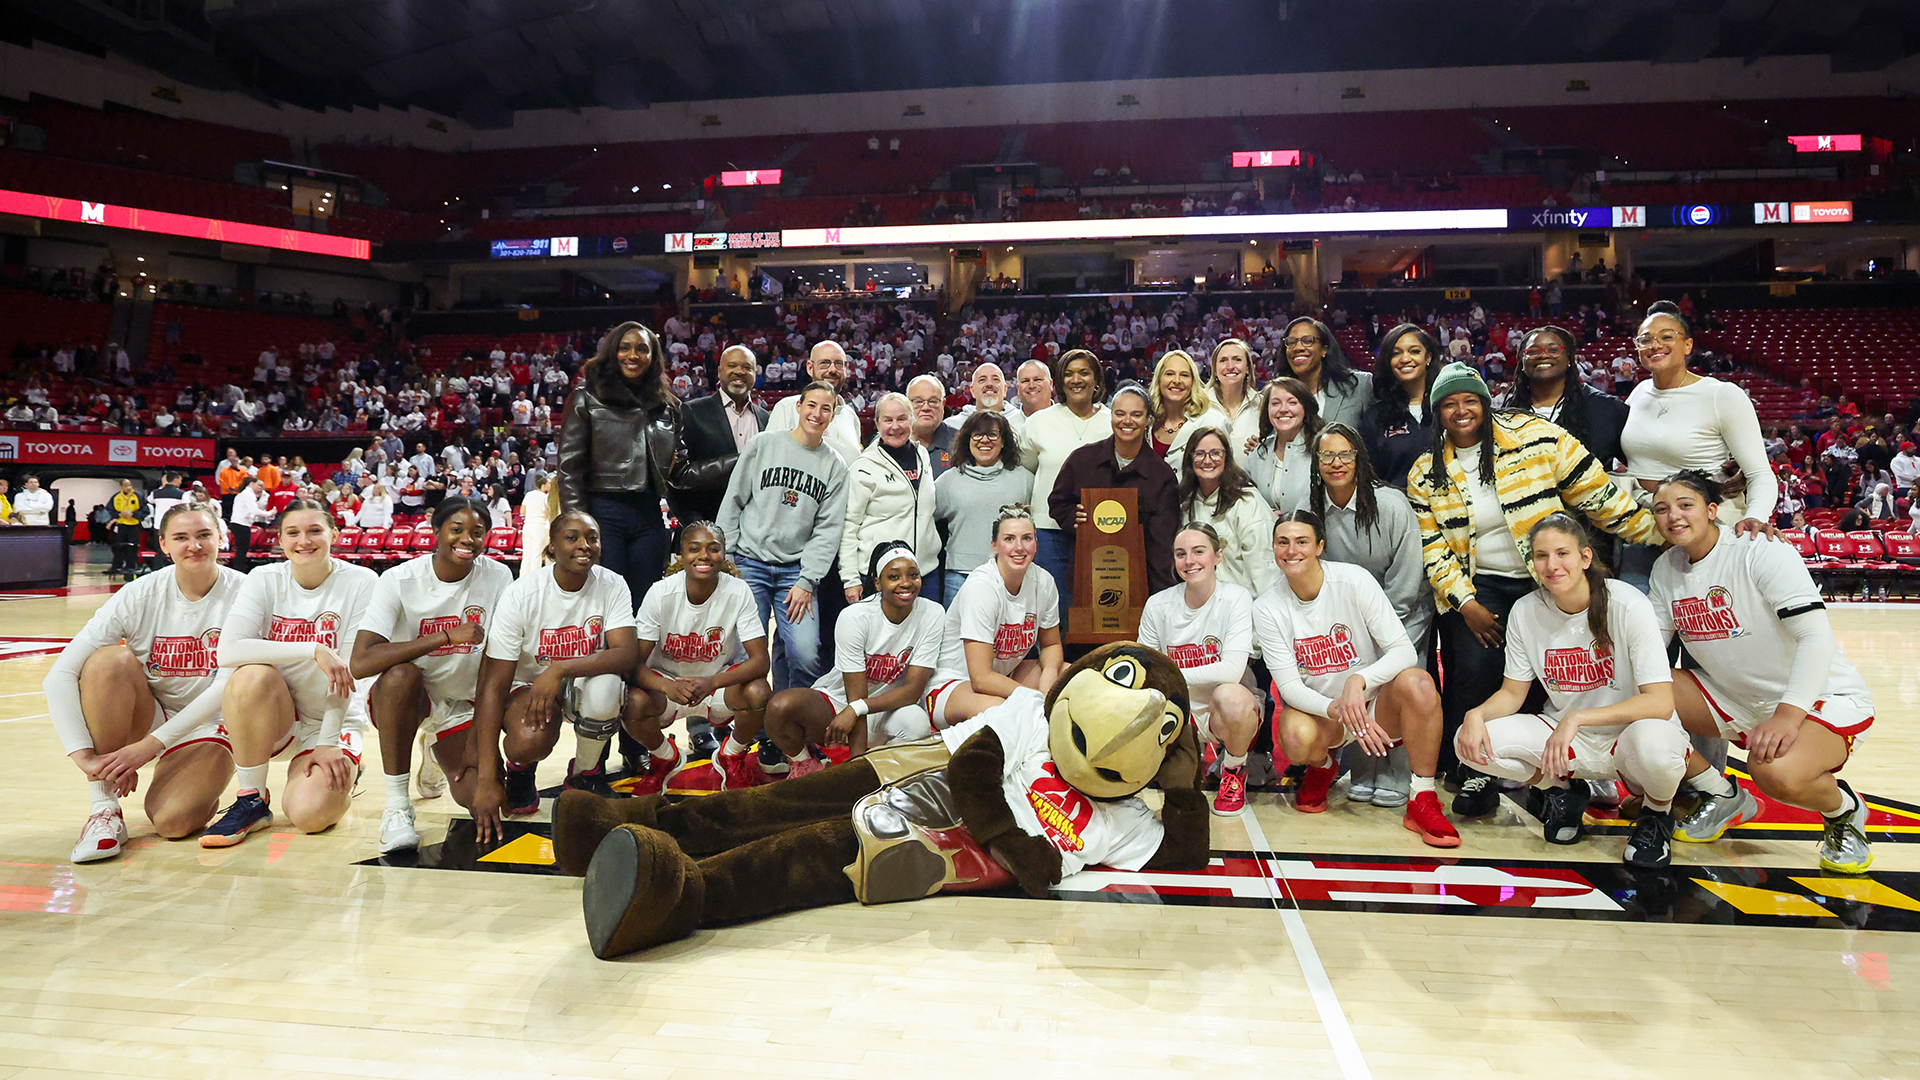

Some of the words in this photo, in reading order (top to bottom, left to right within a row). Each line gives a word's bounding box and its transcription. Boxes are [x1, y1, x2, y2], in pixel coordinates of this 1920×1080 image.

[1818, 136, 1831, 149] M
[1260, 151, 1272, 165] M
[81, 201, 105, 222] M
[1532, 209, 1588, 227] xfinity
[1621, 207, 1638, 223] M
[1763, 204, 1780, 220] M
[1813, 208, 1849, 216] TOYOTA
[672, 234, 685, 248] M
[824, 228, 841, 243] M
[557, 239, 570, 253] M
[728, 239, 780, 248] TERRAPINS
[25, 443, 93, 454] TOYOTA
[142, 447, 204, 458] TOYOTA
[885, 473, 896, 482] M
[760, 466, 827, 505] MARYLAND
[1097, 517, 1126, 526] NCAA
[1710, 596, 1726, 608] M
[1673, 602, 1709, 618] NATIONAL
[272, 621, 317, 634] NATIONAL
[321, 620, 335, 630] M
[1024, 621, 1035, 630] M
[1674, 610, 1734, 631] CHAMPIONS
[208, 637, 220, 648] M
[543, 629, 587, 645] NATIONAL
[668, 636, 705, 648] NATIONAL
[1335, 632, 1348, 643] M
[154, 641, 204, 654] NATIONAL
[664, 642, 719, 657] CHAMPIONS
[1206, 644, 1217, 654] M
[150, 650, 219, 669] CHAMPIONS
[1548, 652, 1592, 667] NATIONAL
[1544, 659, 1614, 682] CHAMPIONS
[1031, 792, 1074, 831] NATIONAL
